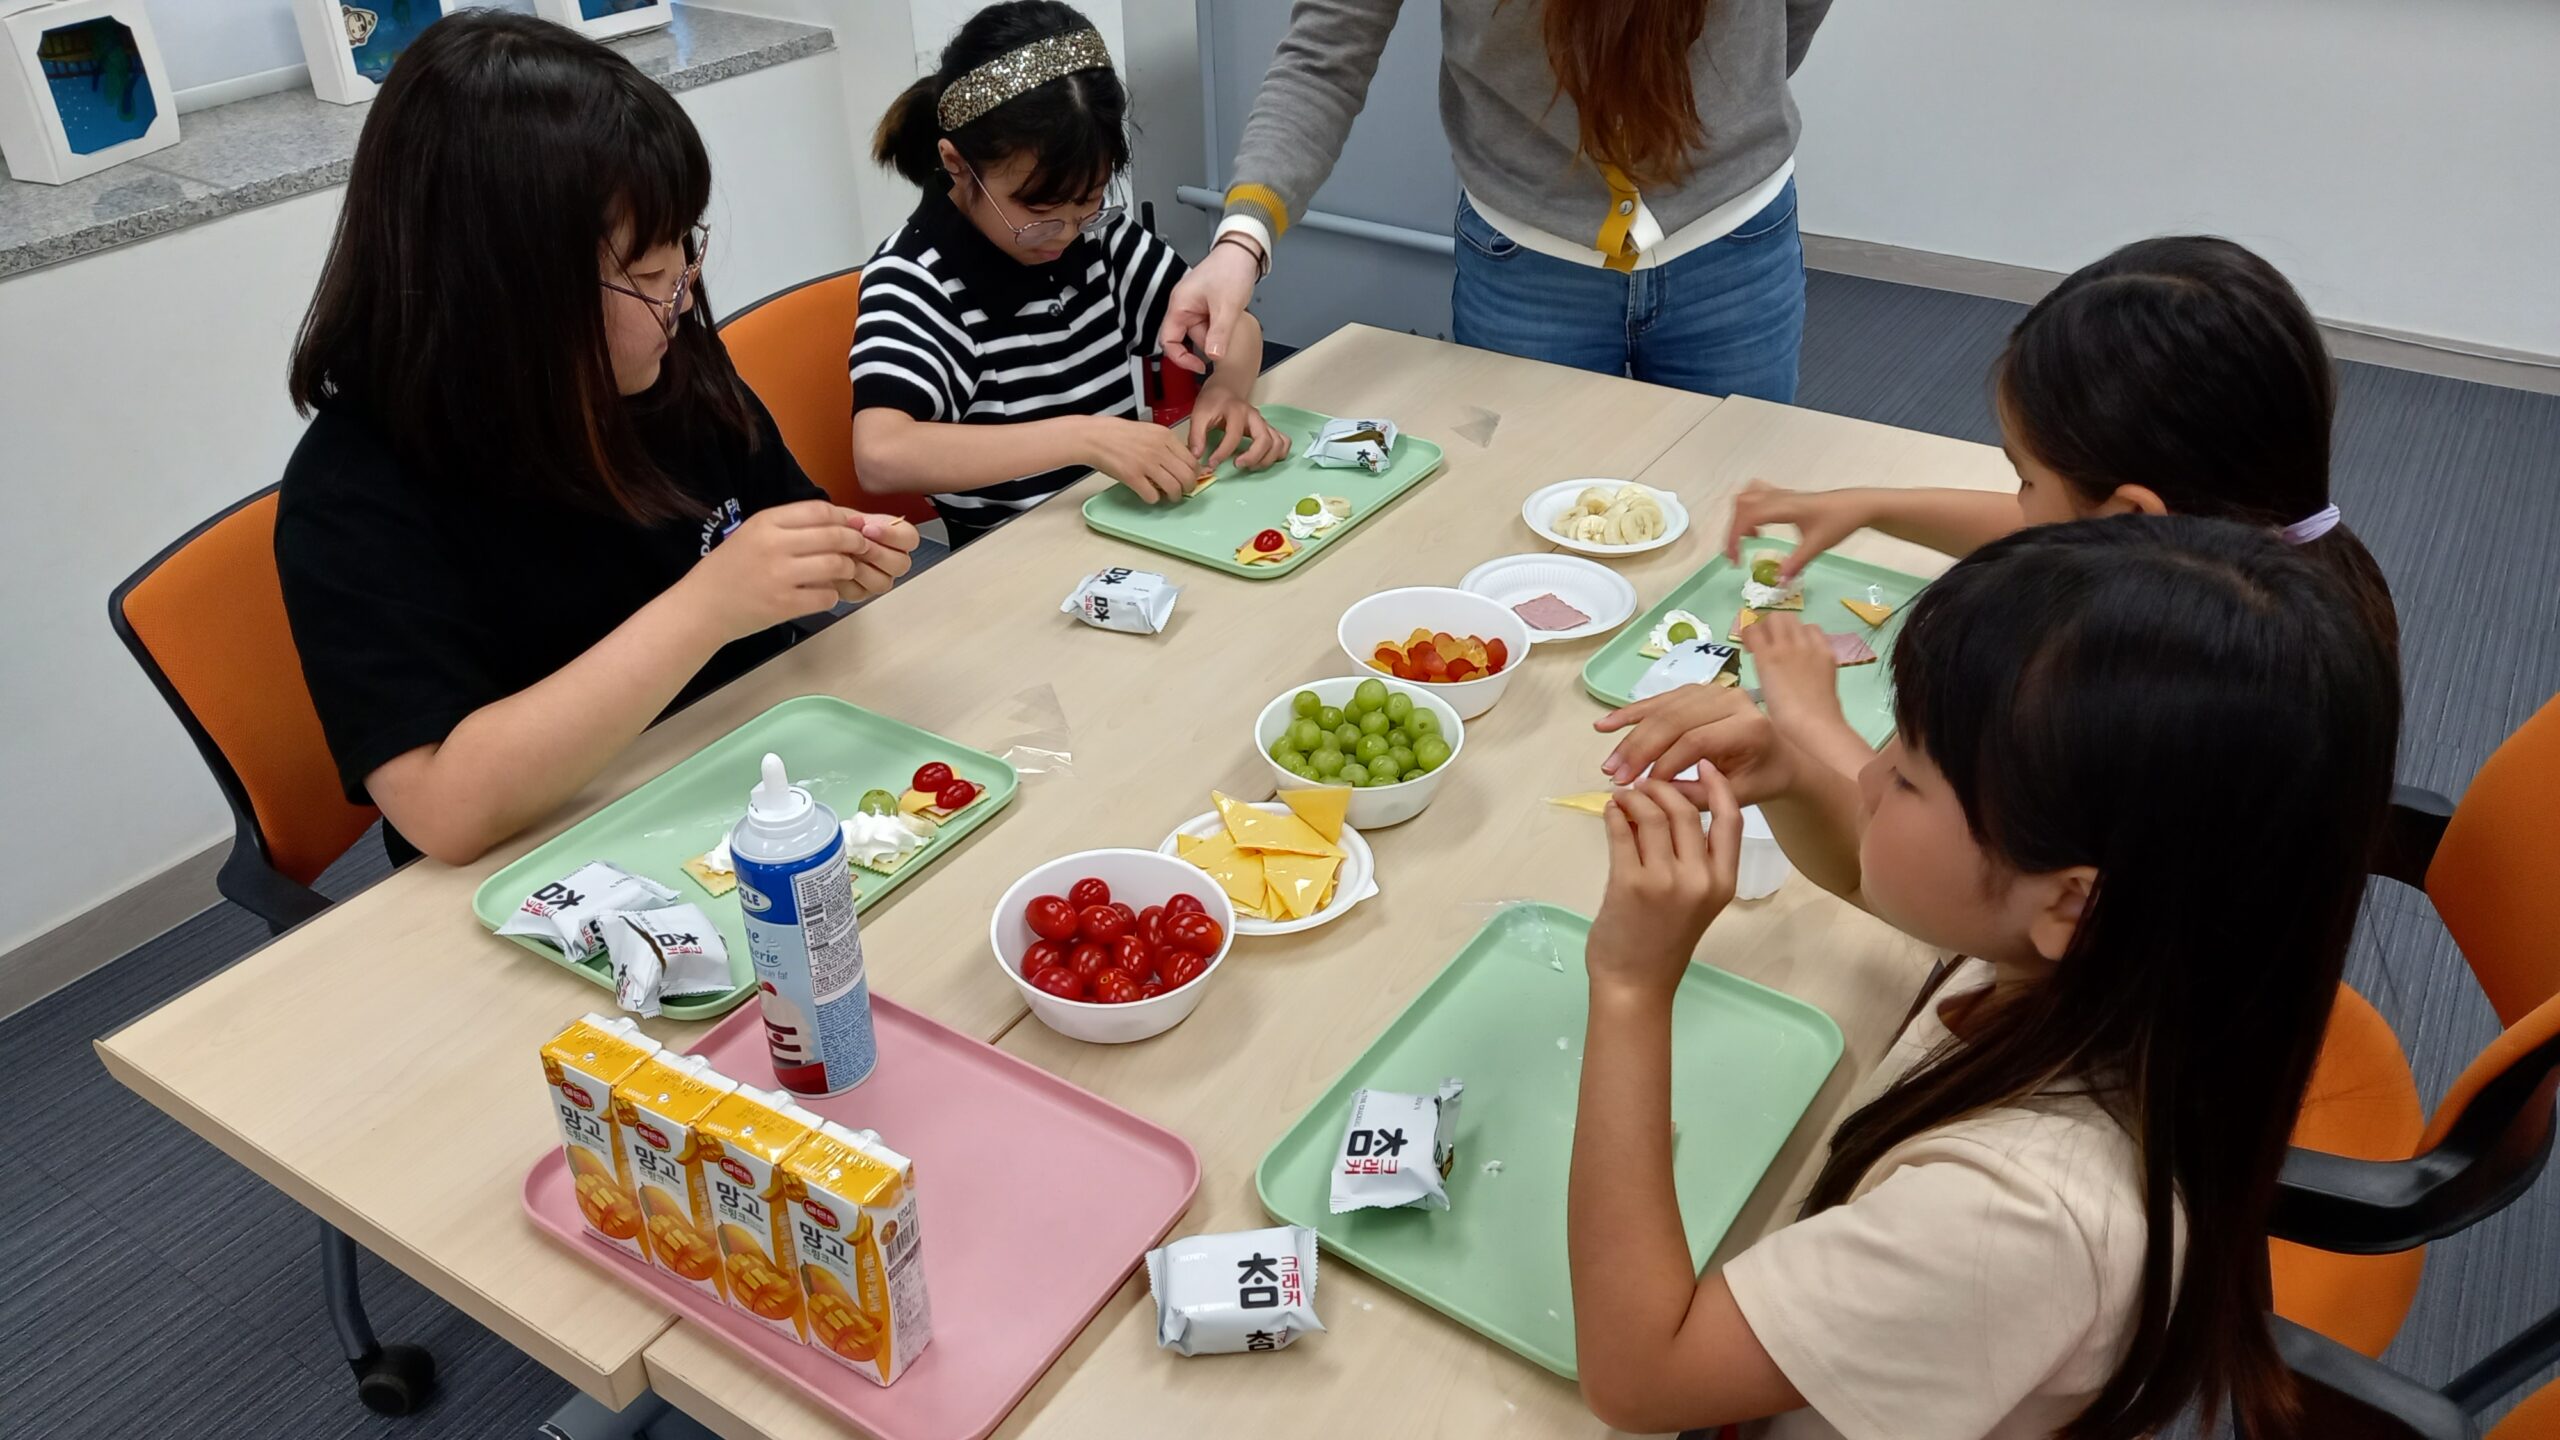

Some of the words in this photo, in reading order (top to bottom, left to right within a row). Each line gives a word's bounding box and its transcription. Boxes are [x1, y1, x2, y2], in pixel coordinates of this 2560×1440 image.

[701, 506, 724, 556] DAILY
[1094, 596, 1110, 622] 참
[520, 898, 558, 920] 크래커
[532, 882, 585, 911] 참
[655, 933, 699, 948] 참
[560, 1103, 605, 1143] 망고
[1346, 1127, 1408, 1157] 참
[634, 1144, 681, 1184] 망고
[1344, 1158, 1398, 1175] 크래커
[716, 1181, 764, 1222] 망고
[799, 1220, 848, 1265] 망고
[1237, 1252, 1279, 1309] 참
[1281, 1255, 1301, 1307] 크래커
[1246, 1329, 1276, 1351] 참
